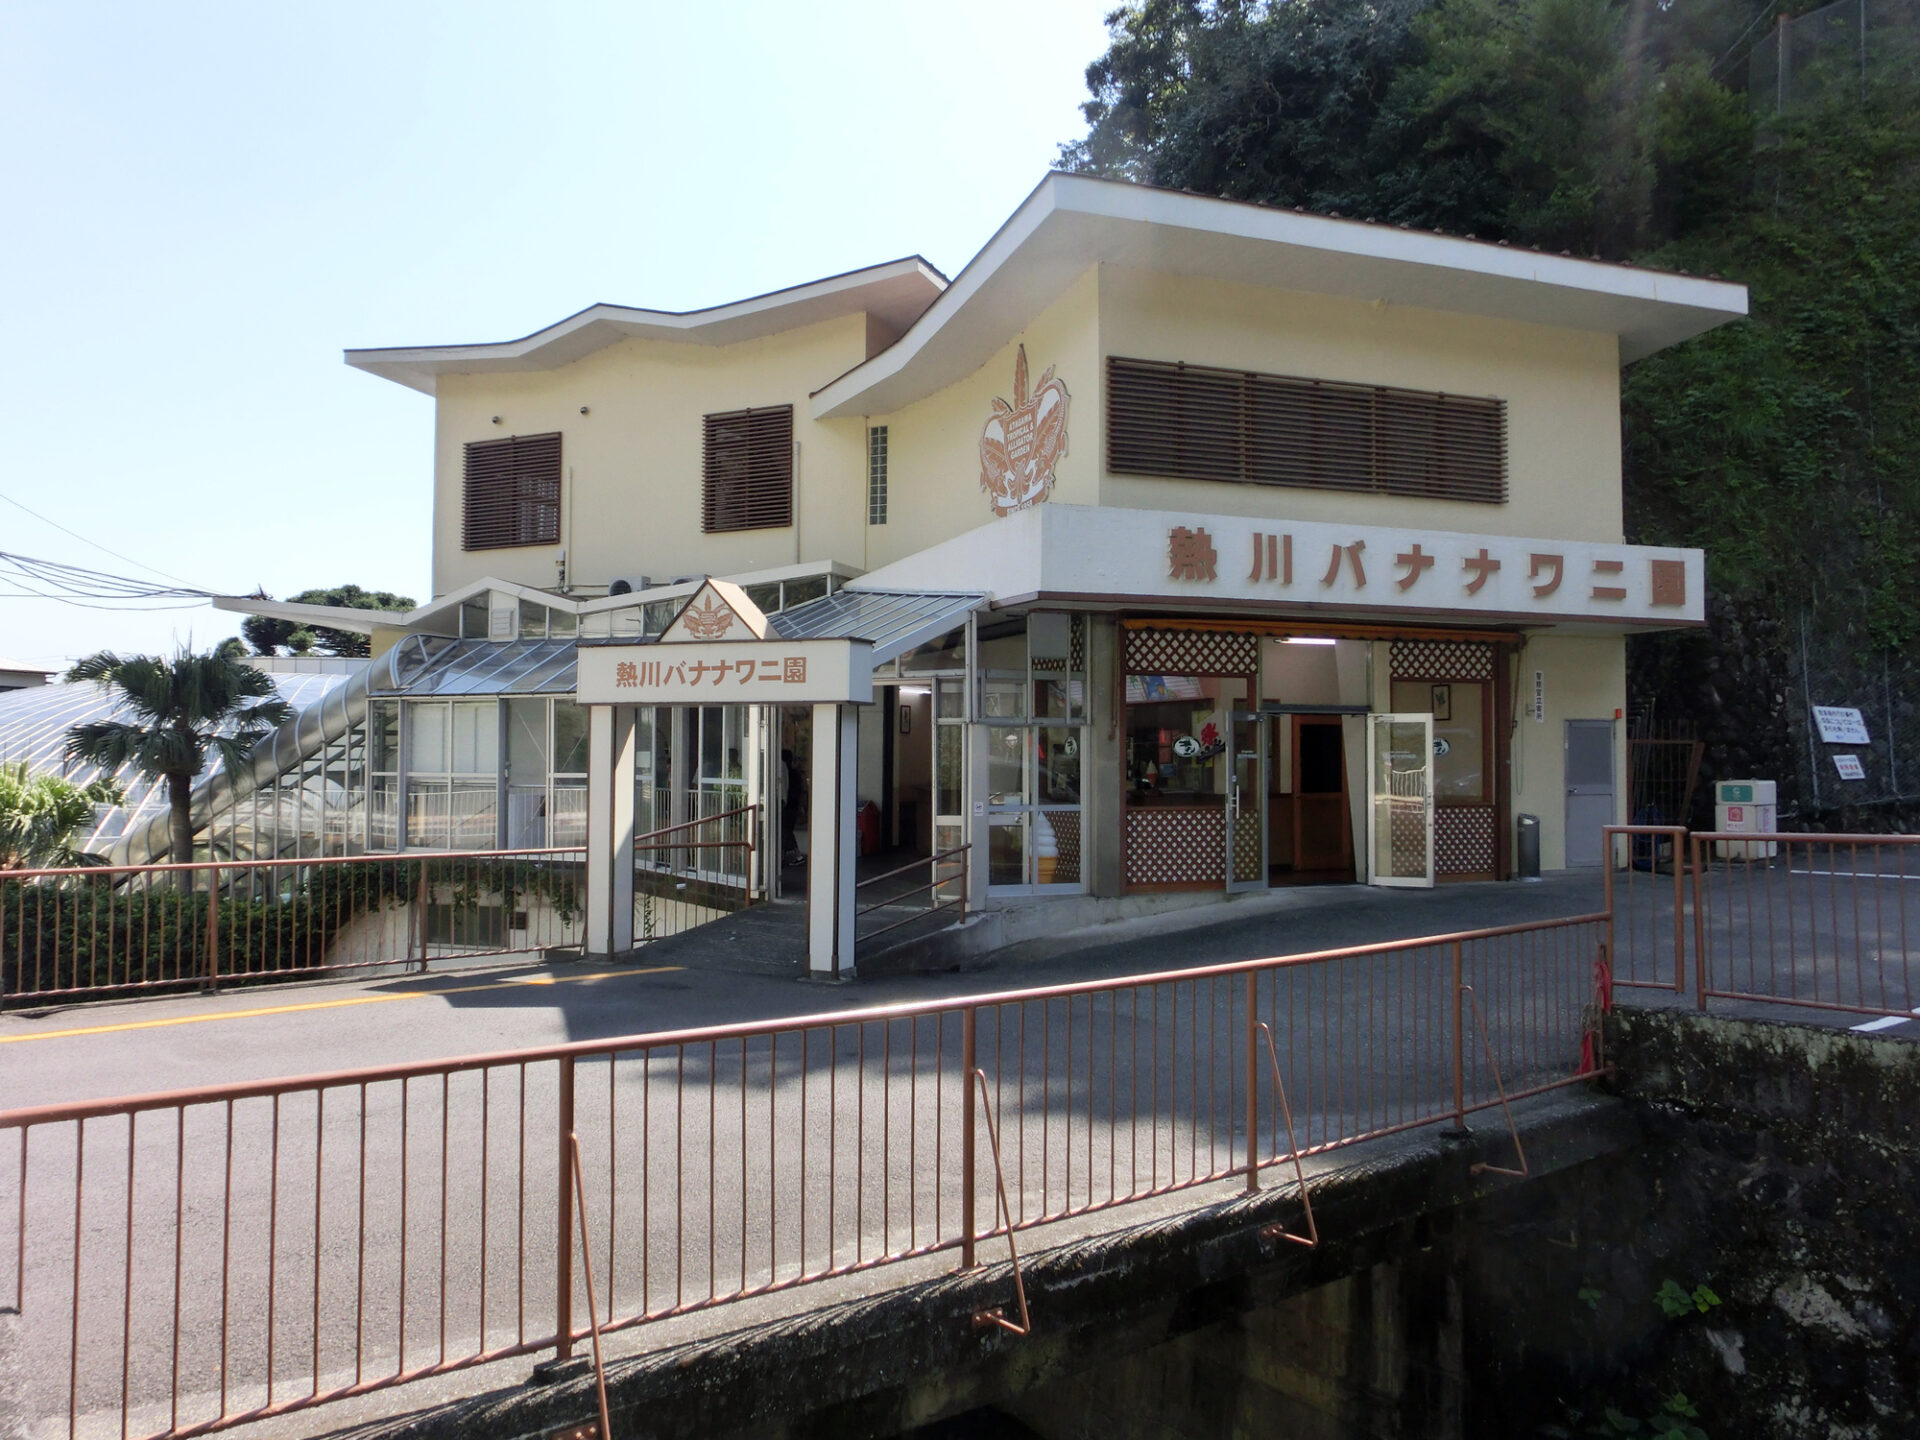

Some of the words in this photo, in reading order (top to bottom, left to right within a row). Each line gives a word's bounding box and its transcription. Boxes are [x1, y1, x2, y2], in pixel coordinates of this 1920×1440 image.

[1007, 424, 1029, 442] TROPICAL
[1008, 432, 1034, 451] ALLIGATOR
[1010, 443, 1030, 459] GARDEN
[1169, 527, 1686, 605] 熱川バナナワニ園
[616, 656, 807, 688] 熱川バナナワニ園
